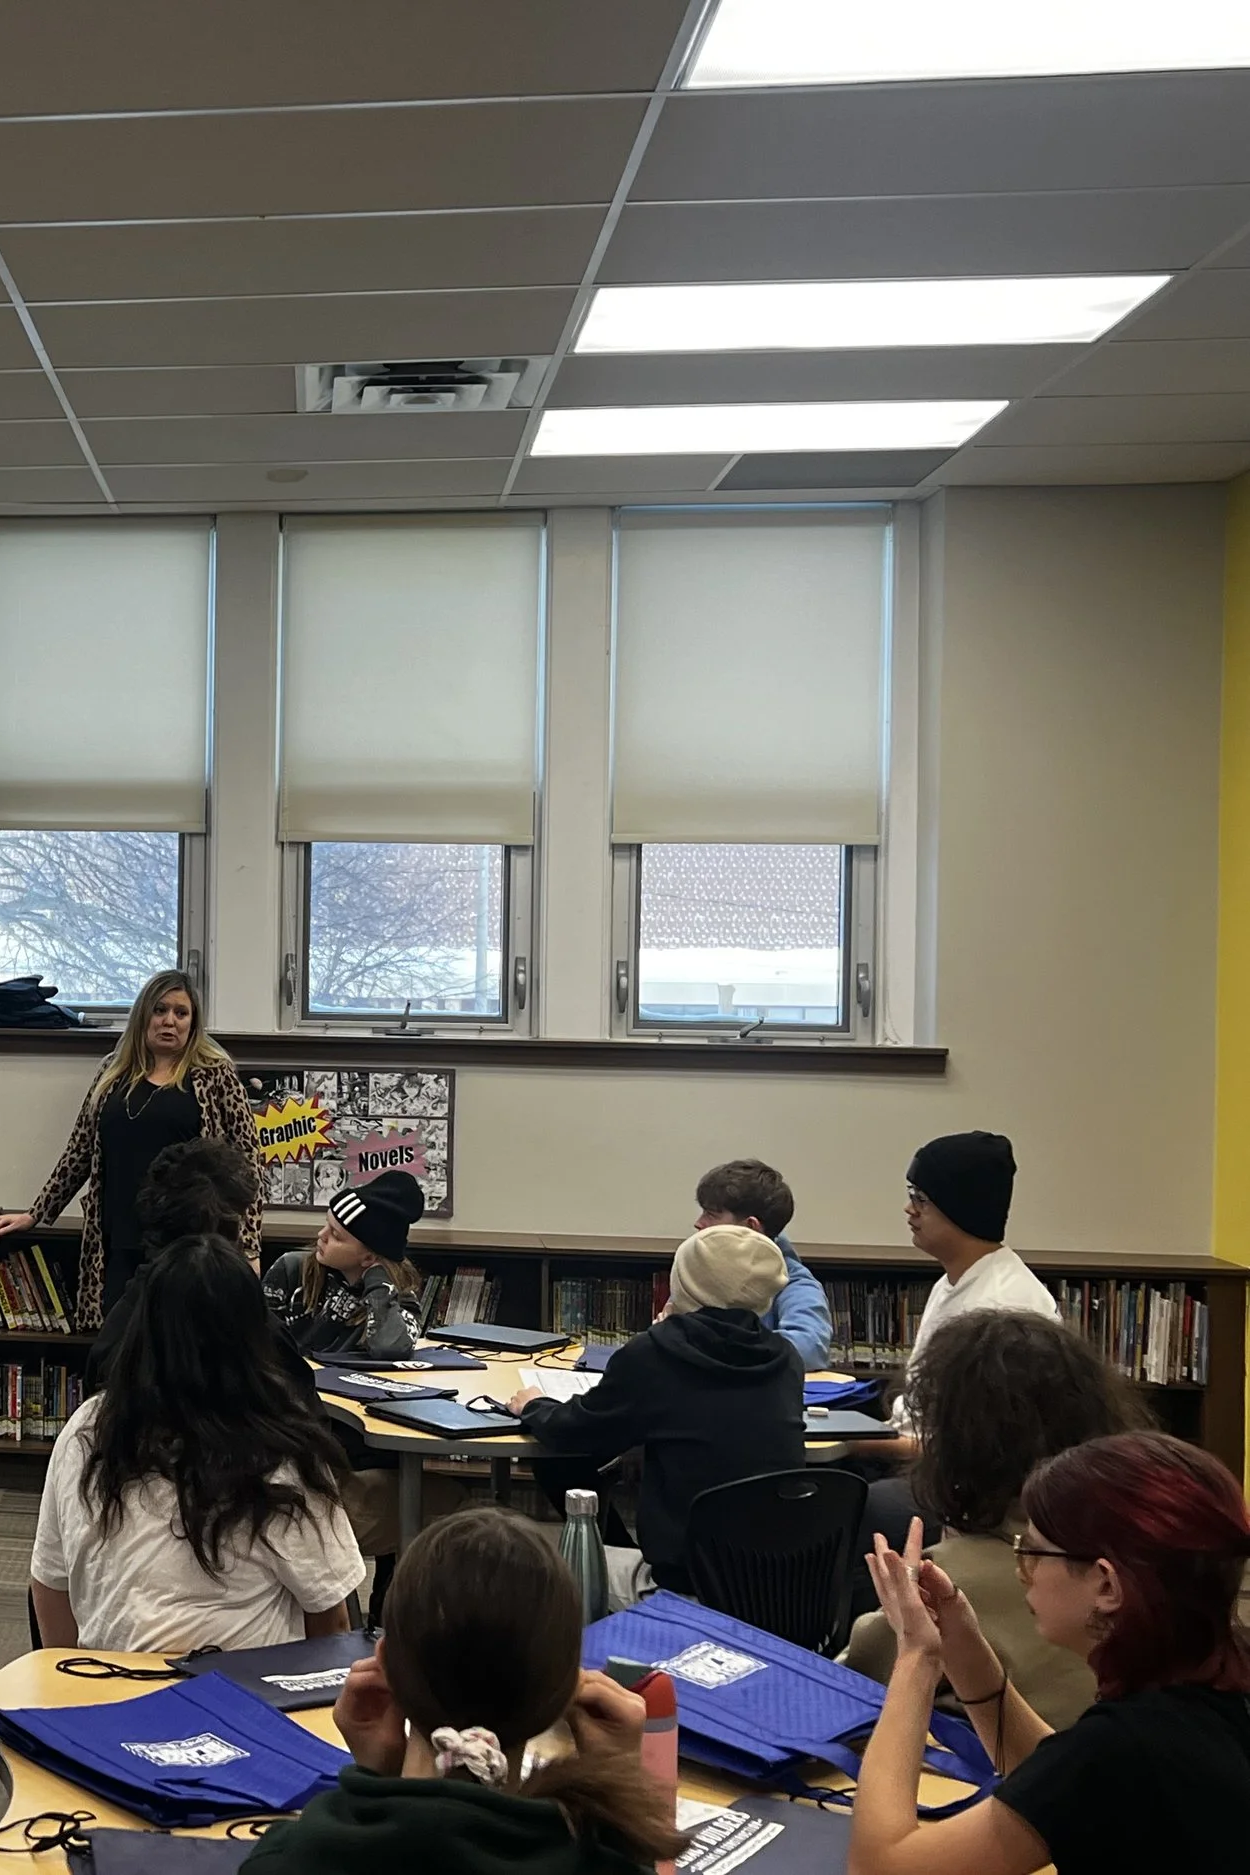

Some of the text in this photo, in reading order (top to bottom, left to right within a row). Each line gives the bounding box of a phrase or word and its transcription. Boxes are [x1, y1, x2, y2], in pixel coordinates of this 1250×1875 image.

[259, 1115, 317, 1147] Graphic
[358, 1144, 414, 1172] Novels
[695, 1811, 751, 1846] BUILDERS
